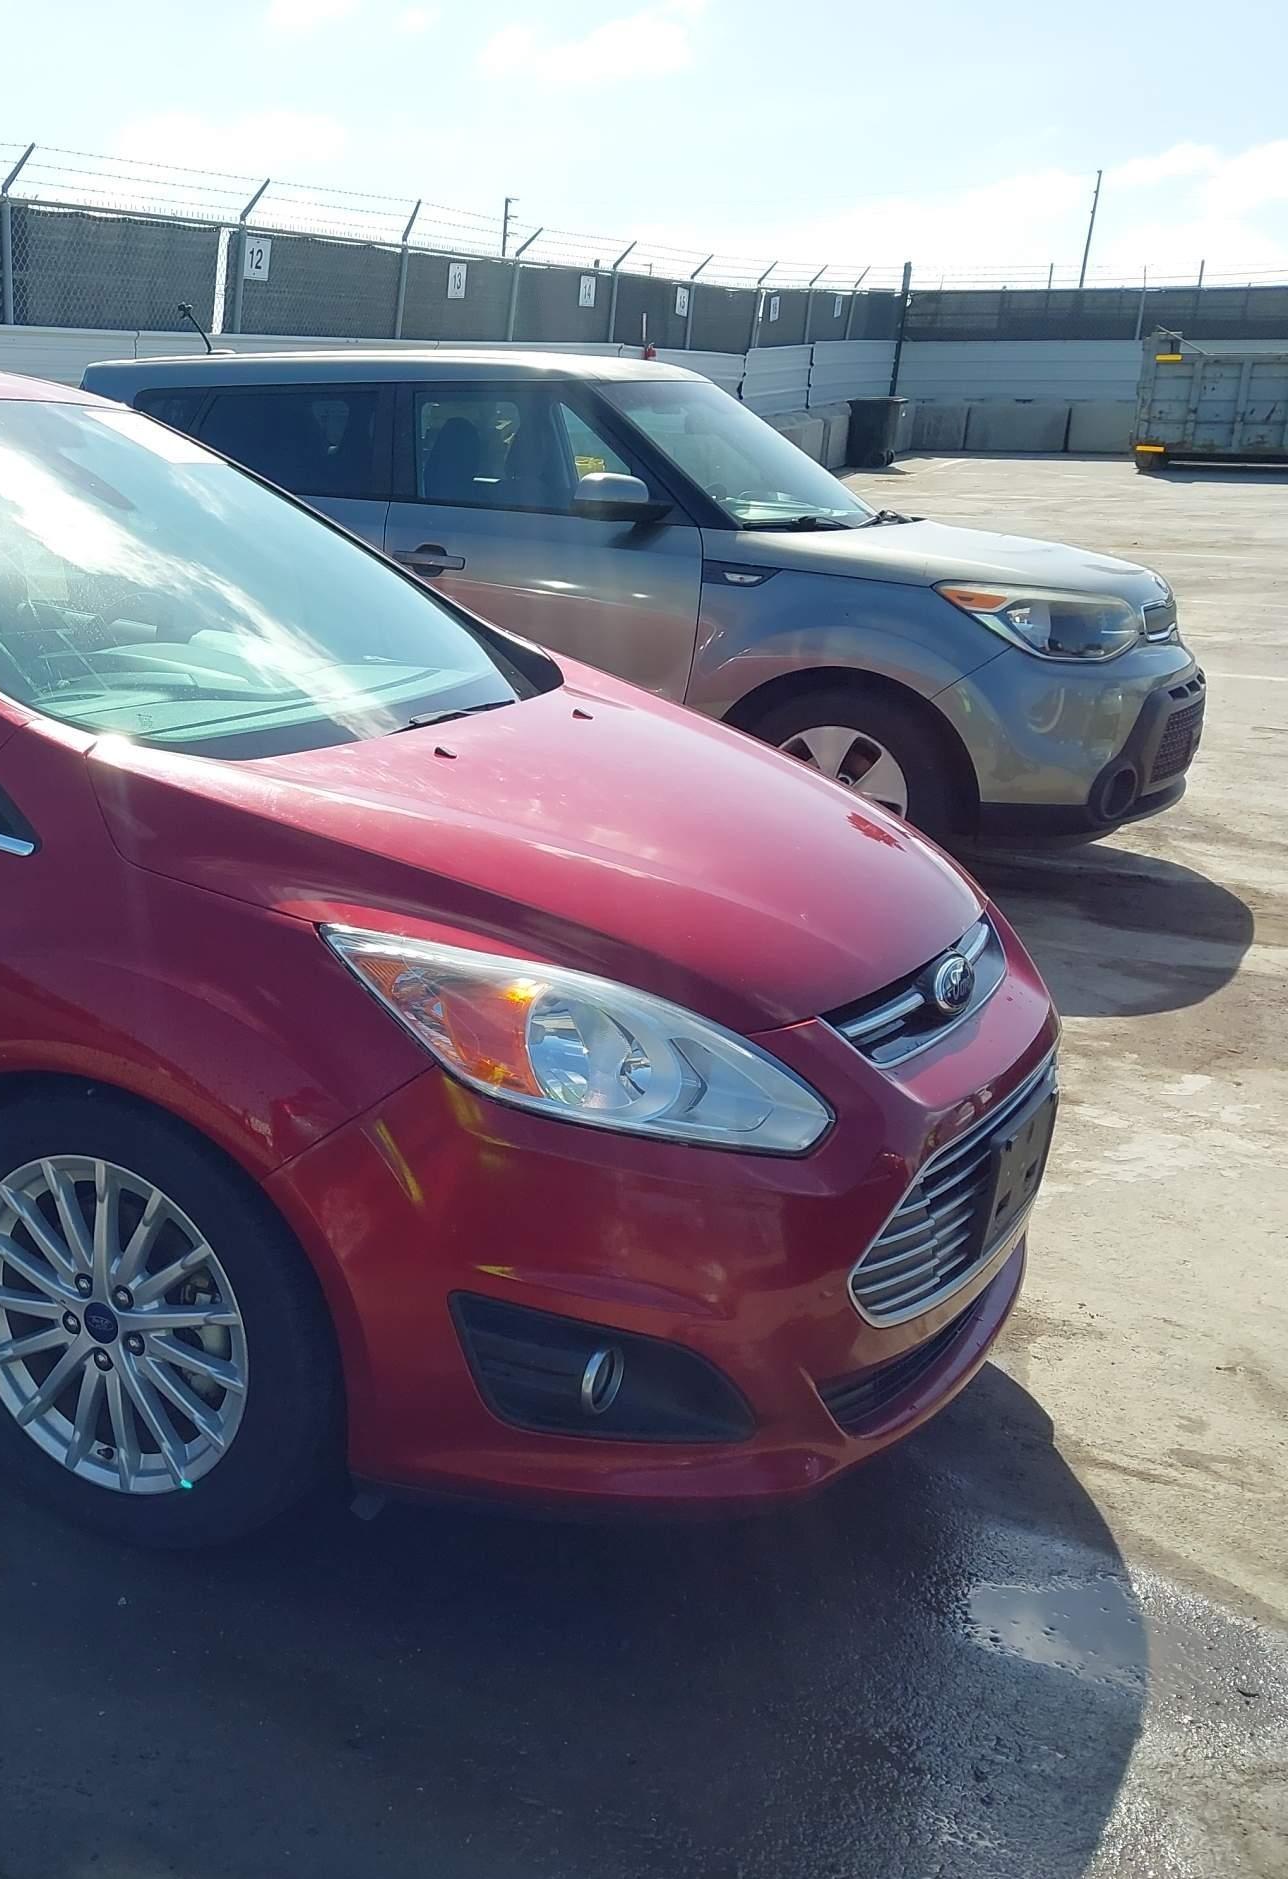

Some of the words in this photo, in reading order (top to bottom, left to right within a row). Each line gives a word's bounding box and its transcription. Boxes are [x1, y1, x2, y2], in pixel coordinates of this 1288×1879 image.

[249, 247, 264, 270] 12
[453, 271, 462, 290] 13
[584, 284, 592, 299] 14
